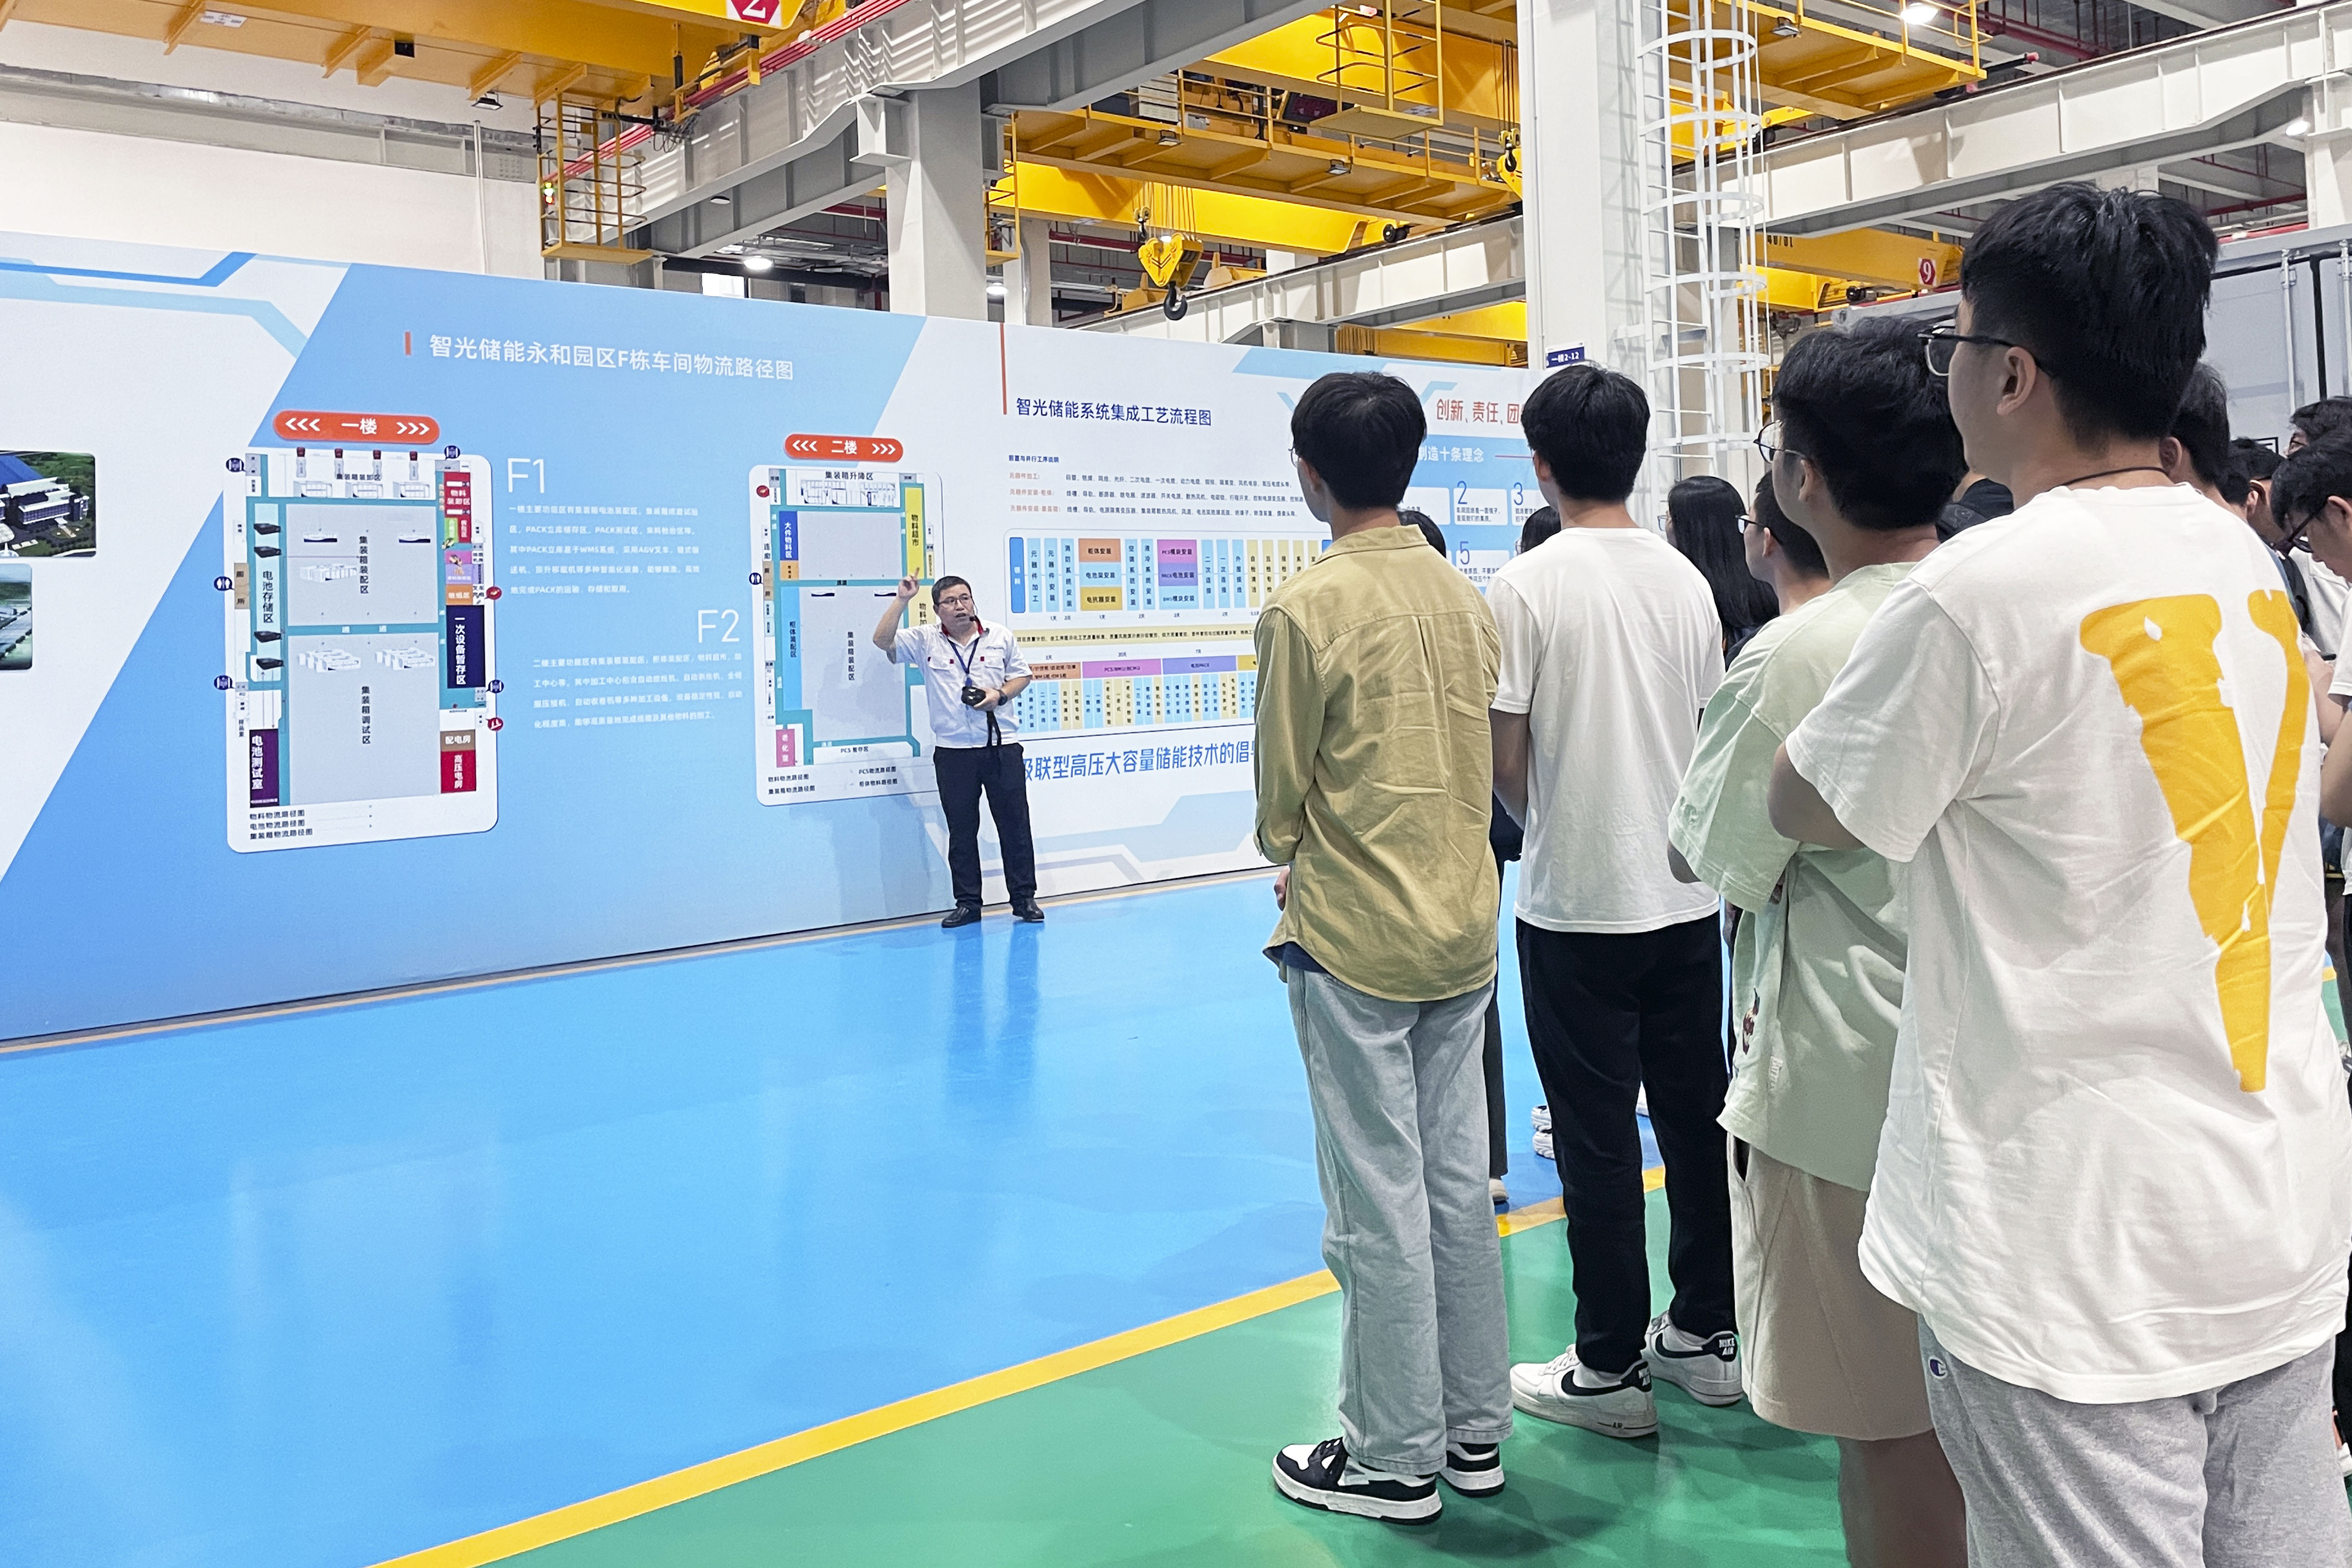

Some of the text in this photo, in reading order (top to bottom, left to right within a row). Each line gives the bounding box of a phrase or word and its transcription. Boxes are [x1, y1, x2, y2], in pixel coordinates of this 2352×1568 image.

[1923, 262, 1931, 282] 9
[430, 334, 794, 381] 智光储能永和园区F栋车间物流路径图
[1016, 397, 1212, 426] 智光储能系统集成工艺流程图
[1437, 399, 1523, 424] 创新、责任、团
[341, 418, 378, 435] 一楼
[831, 440, 857, 454] 二楼
[507, 458, 545, 493] F1
[1457, 481, 1467, 504] 2
[1514, 482, 1523, 505] 3
[1460, 541, 1470, 564] 5
[263, 571, 274, 623] 电池存储区
[697, 609, 740, 643] F2
[454, 616, 466, 685] 一次设备暂存区
[361, 686, 371, 744] 集装箱调试区
[1719, 1338, 1735, 1348] NIKE
[1722, 1347, 1734, 1356] AIR
